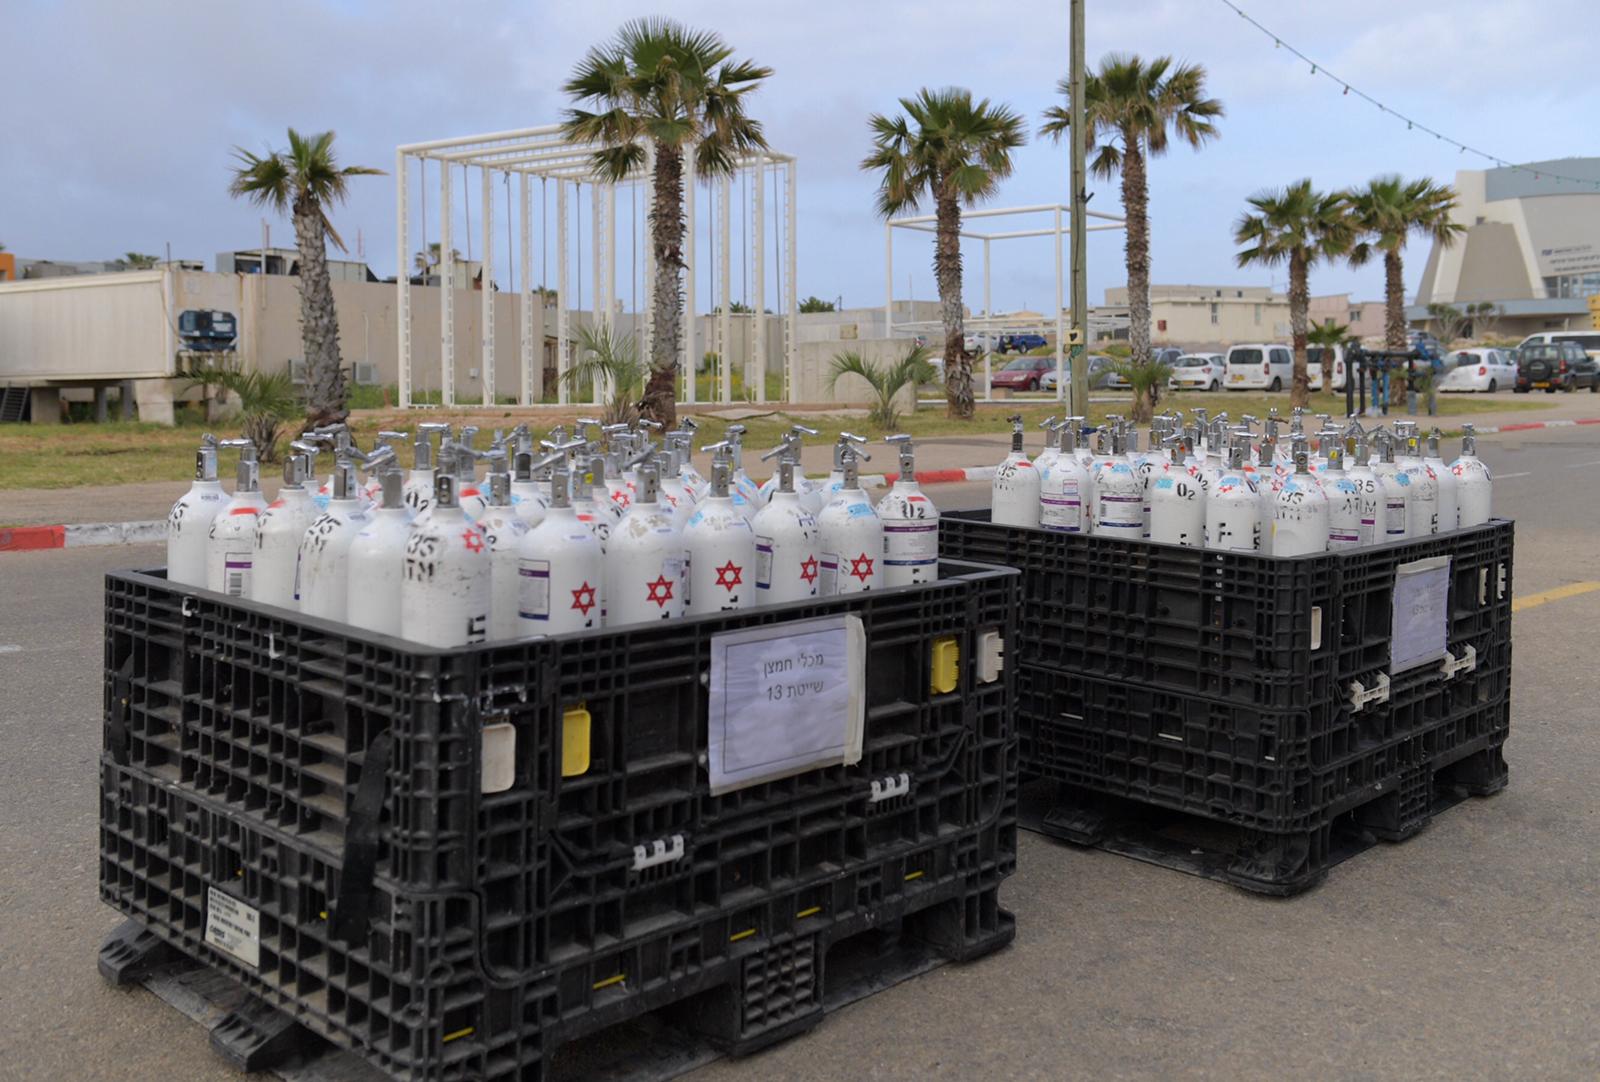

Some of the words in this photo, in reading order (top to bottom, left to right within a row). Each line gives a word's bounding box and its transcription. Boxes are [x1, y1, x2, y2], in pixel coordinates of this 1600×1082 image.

[764, 658, 793, 678] חמצן
[797, 652, 824, 668] מכלי
[767, 684, 783, 700] 13
[786, 681, 824, 698] שייטת
